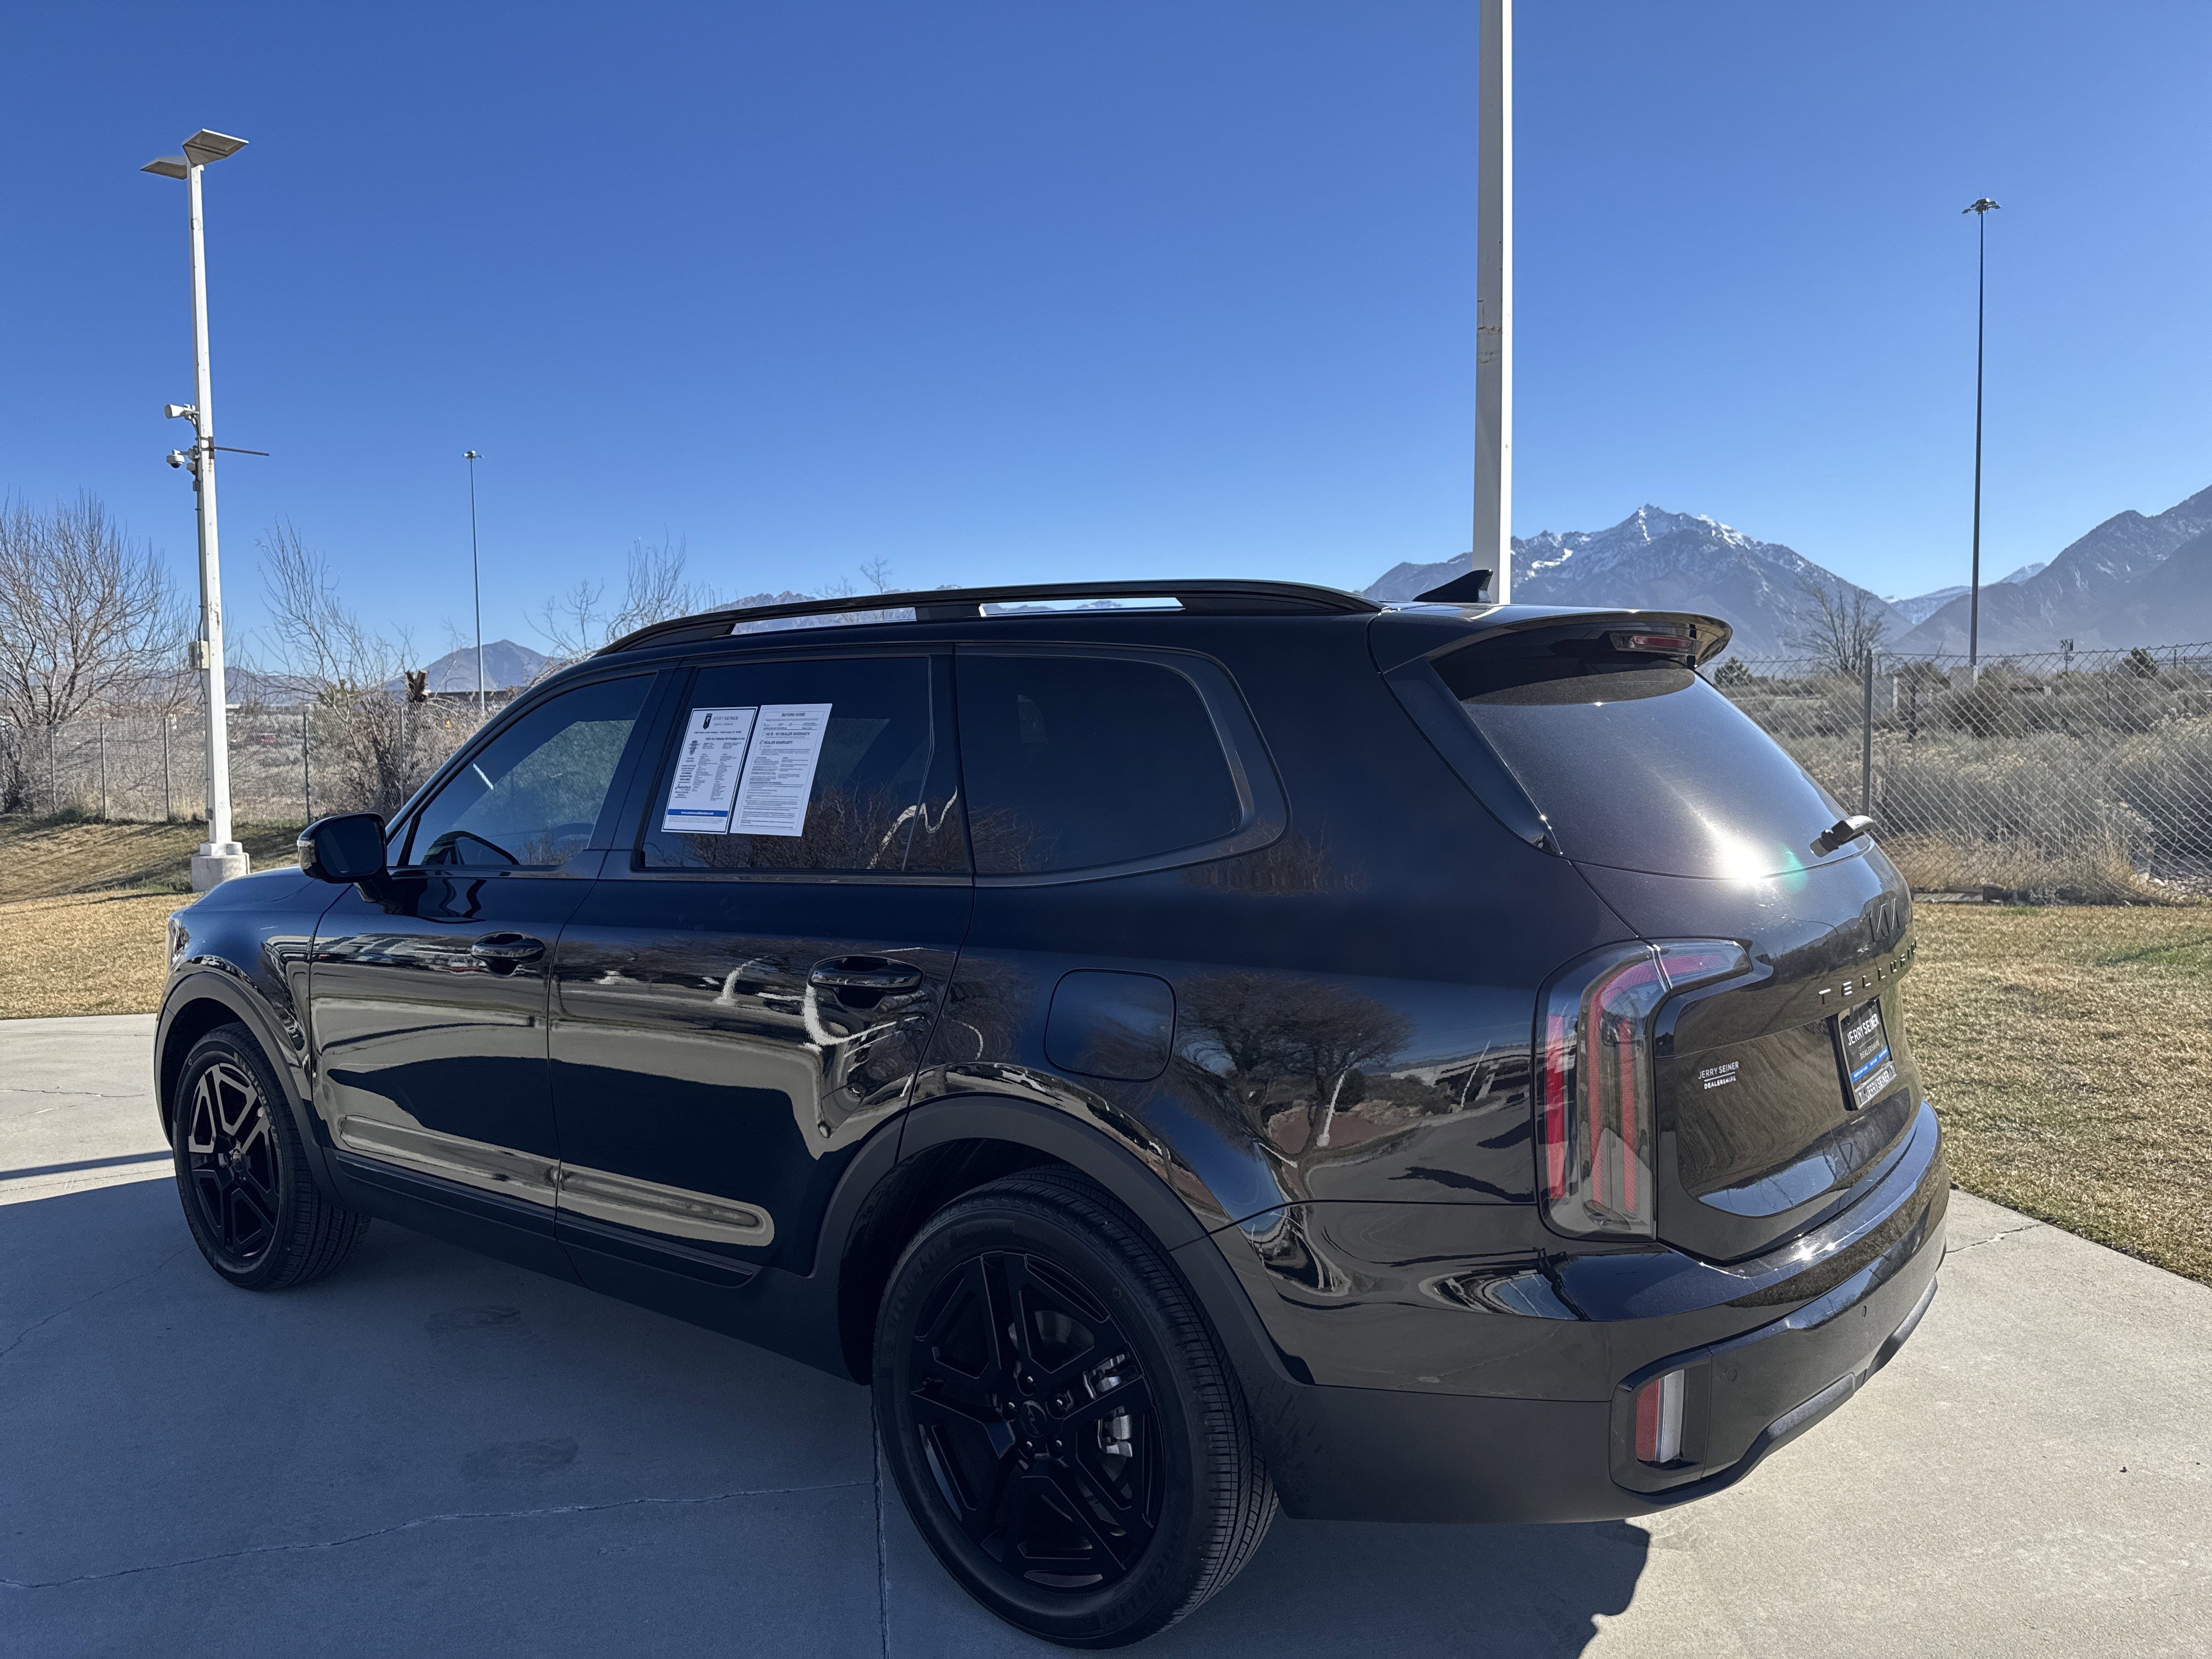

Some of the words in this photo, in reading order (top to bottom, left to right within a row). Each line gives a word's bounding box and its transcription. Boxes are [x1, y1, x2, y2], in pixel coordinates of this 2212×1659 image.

[1847, 1024, 1864, 1046] JERRY
[1862, 1013, 1880, 1035] SEINER
[1698, 1066, 1718, 1080] JERRY
[1718, 1061, 1739, 1074] SEINER
[1704, 1075, 1737, 1090] DEALERSHIPS
